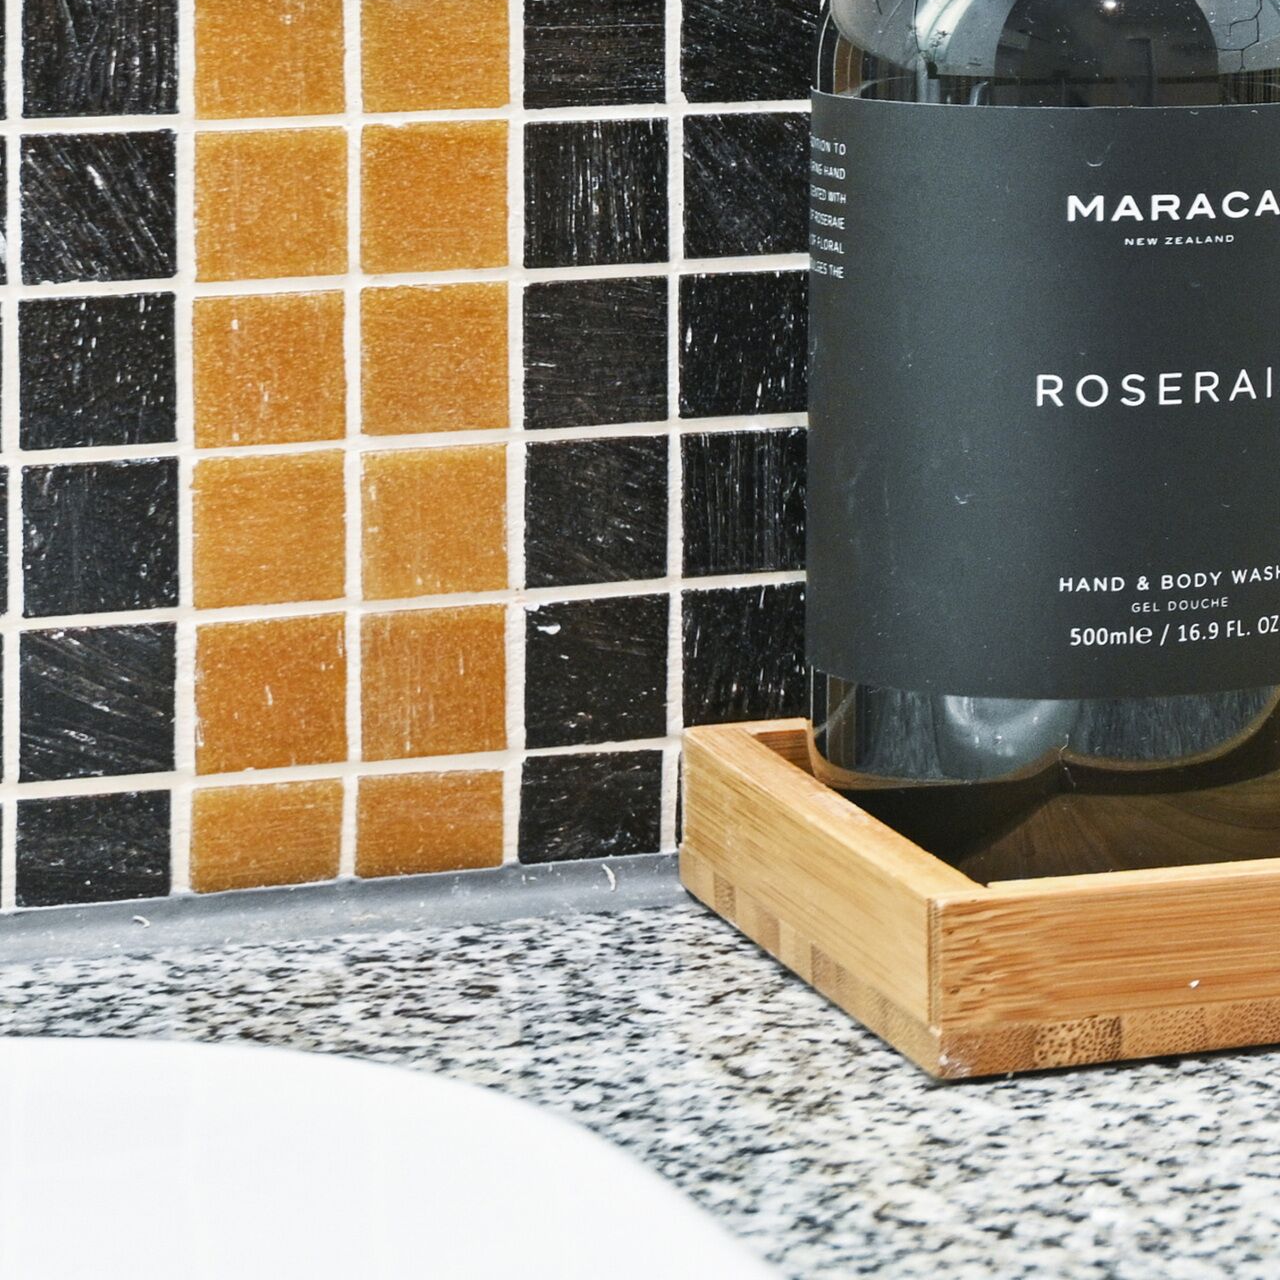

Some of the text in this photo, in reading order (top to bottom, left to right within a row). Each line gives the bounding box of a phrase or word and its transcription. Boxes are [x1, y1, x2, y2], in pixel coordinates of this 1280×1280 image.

[1066, 189, 1280, 223] MARACA
[1124, 234, 1235, 246] NEW ZEALAND
[1059, 576, 1126, 593] HAND
[1136, 575, 1150, 591] &
[1160, 571, 1222, 590] BODY
[1131, 596, 1228, 614] GEL DOUCHE
[1159, 623, 1170, 647] /
[1178, 621, 1219, 643] 16.9
[1226, 619, 1251, 638] FL.
[1257, 614, 1279, 635] OZ
